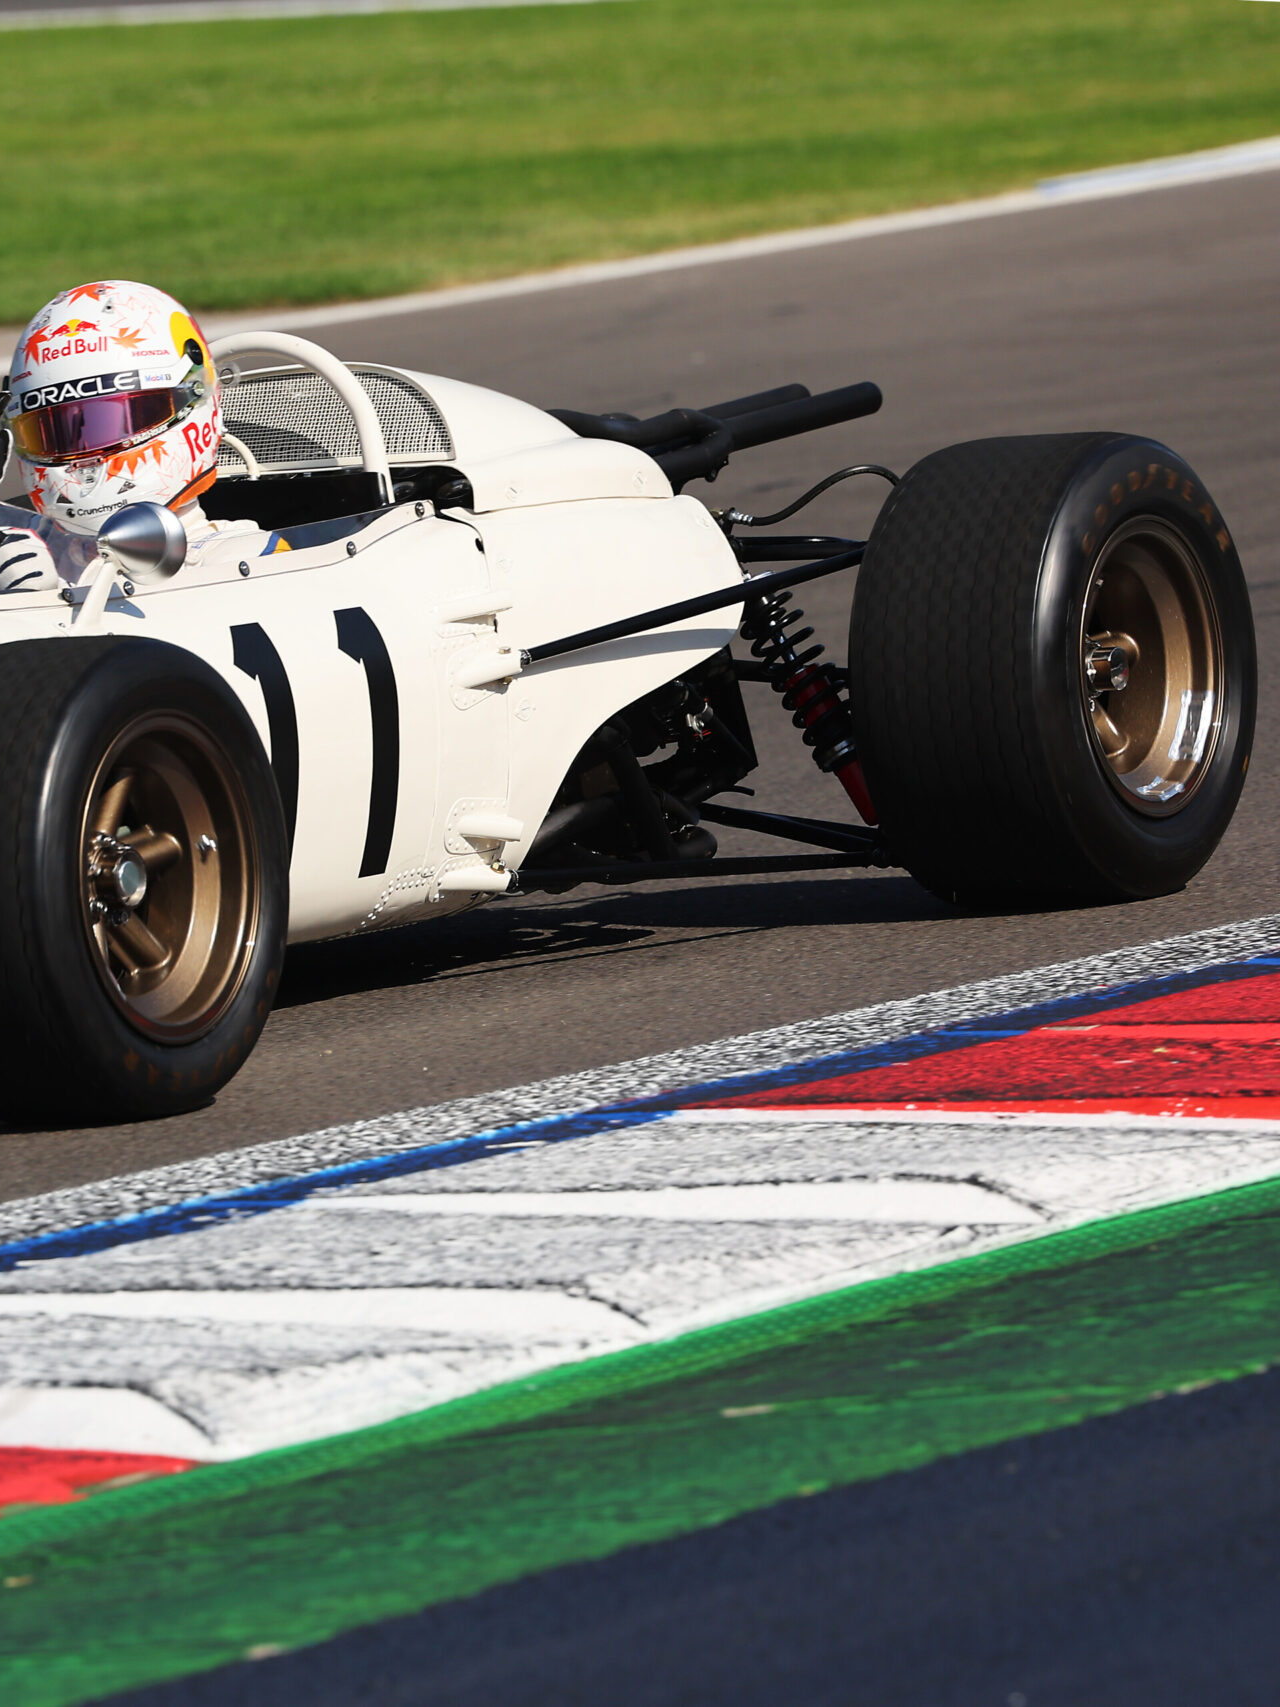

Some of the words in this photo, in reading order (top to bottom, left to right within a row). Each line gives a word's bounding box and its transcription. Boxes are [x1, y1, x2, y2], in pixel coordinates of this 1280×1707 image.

[41, 340, 71, 364] Red
[74, 336, 108, 355] Bull
[131, 349, 170, 357] HONDA
[23, 371, 140, 410] ORACLE
[77, 499, 128, 517] Crunchyroll
[229, 606, 400, 879] 11
